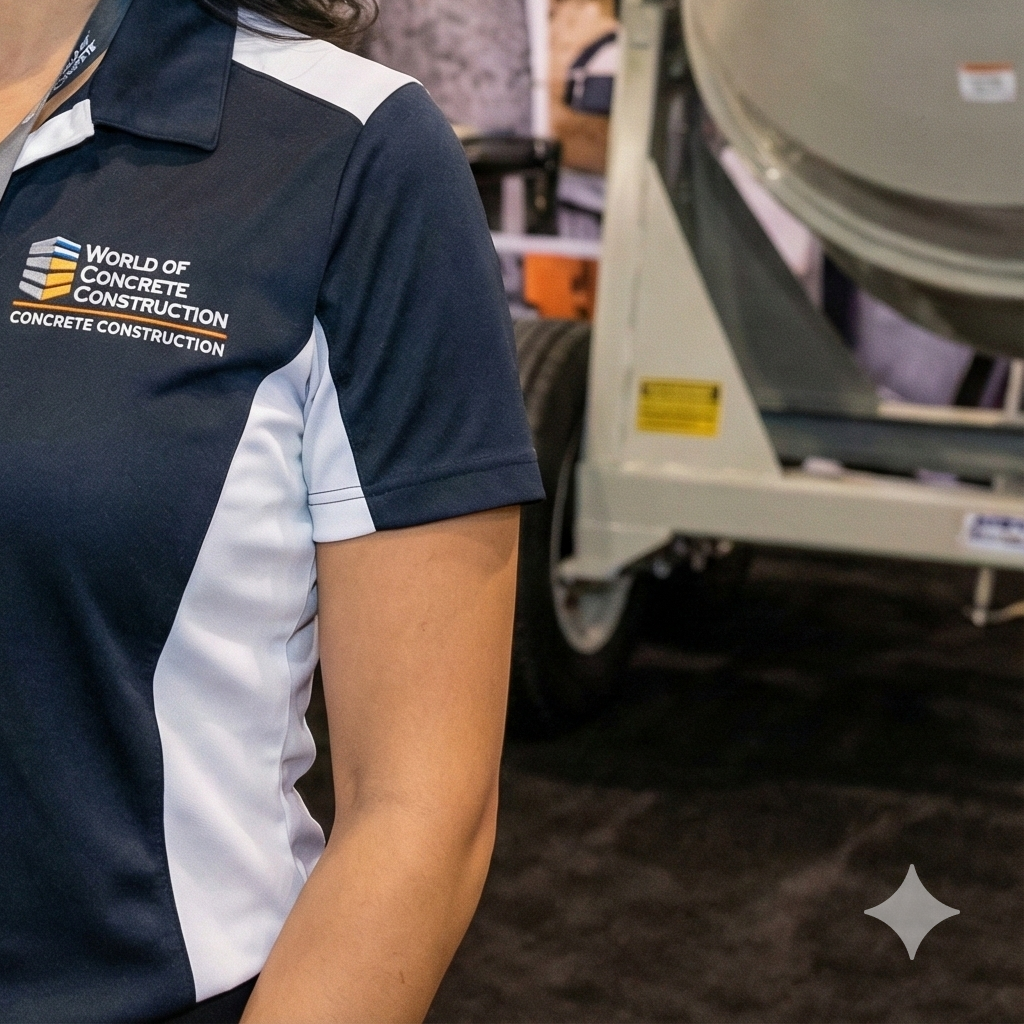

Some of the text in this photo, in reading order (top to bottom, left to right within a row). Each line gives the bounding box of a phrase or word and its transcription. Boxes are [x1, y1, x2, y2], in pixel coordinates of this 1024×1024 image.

[86, 244, 191, 275] WORLD OF
[80, 265, 190, 298] CONCRETE
[73, 286, 229, 329] CONSTRUCTION
[9, 310, 225, 357] CONCRETE CONSTRUCTION
